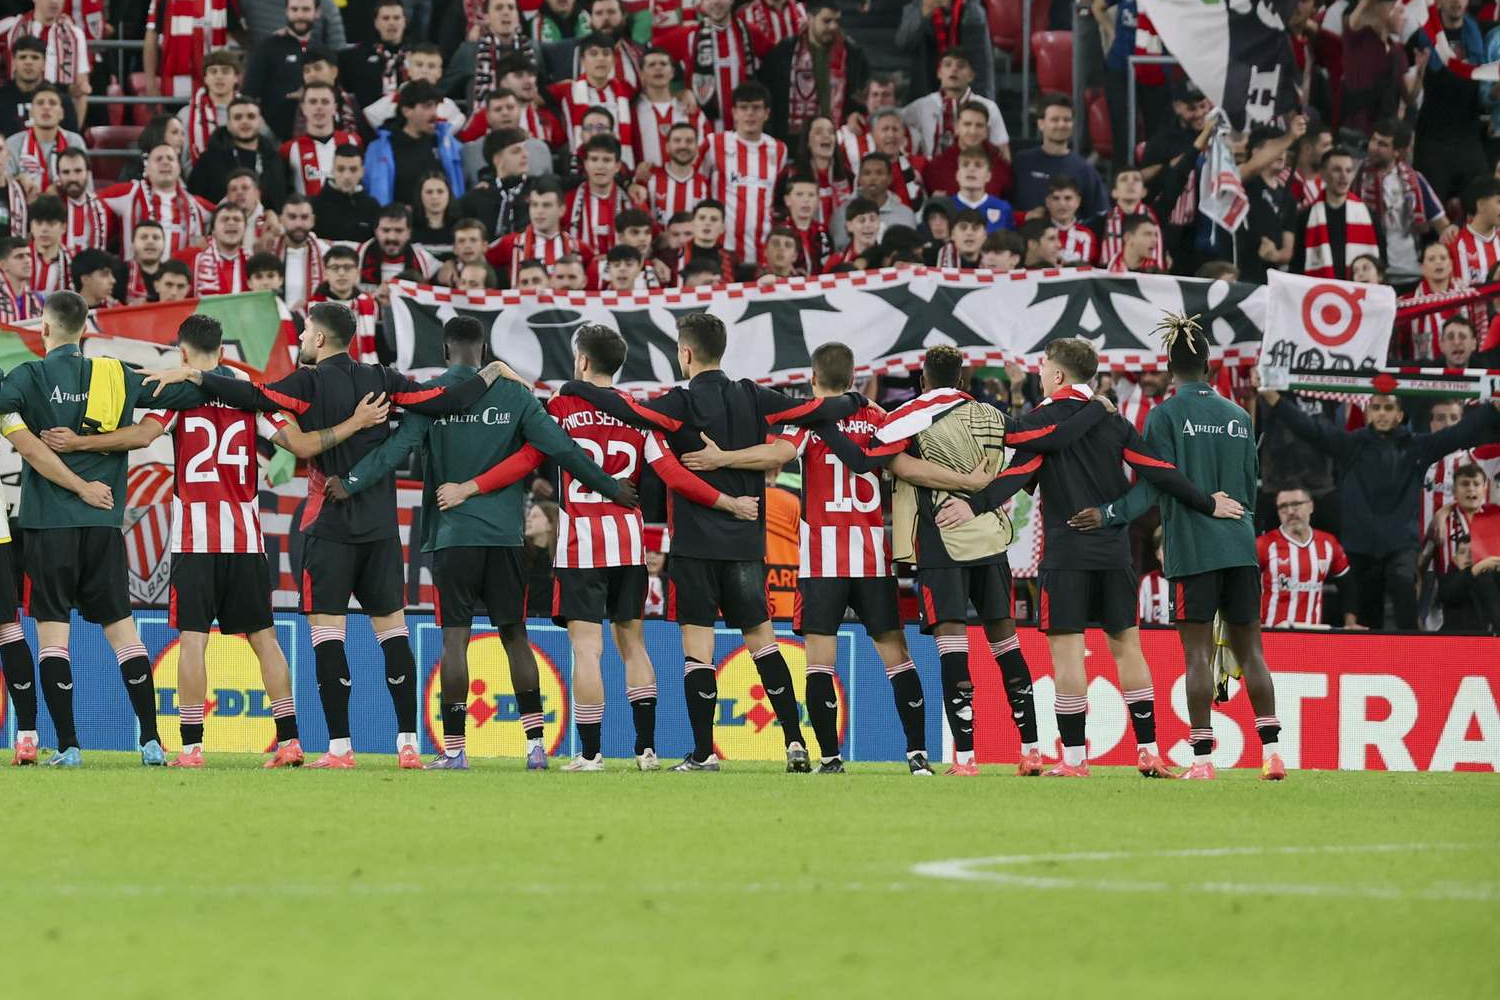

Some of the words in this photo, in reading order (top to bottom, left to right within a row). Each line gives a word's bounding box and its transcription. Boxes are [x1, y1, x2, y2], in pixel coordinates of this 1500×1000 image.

[1297, 374, 1359, 386] PALESTINE
[1410, 379, 1473, 391] PALESTINE
[562, 410, 594, 431] NICO
[1183, 418, 1225, 436] ATHLETIC
[184, 416, 249, 485] 24
[568, 436, 638, 503] 22
[825, 453, 882, 514] 16
